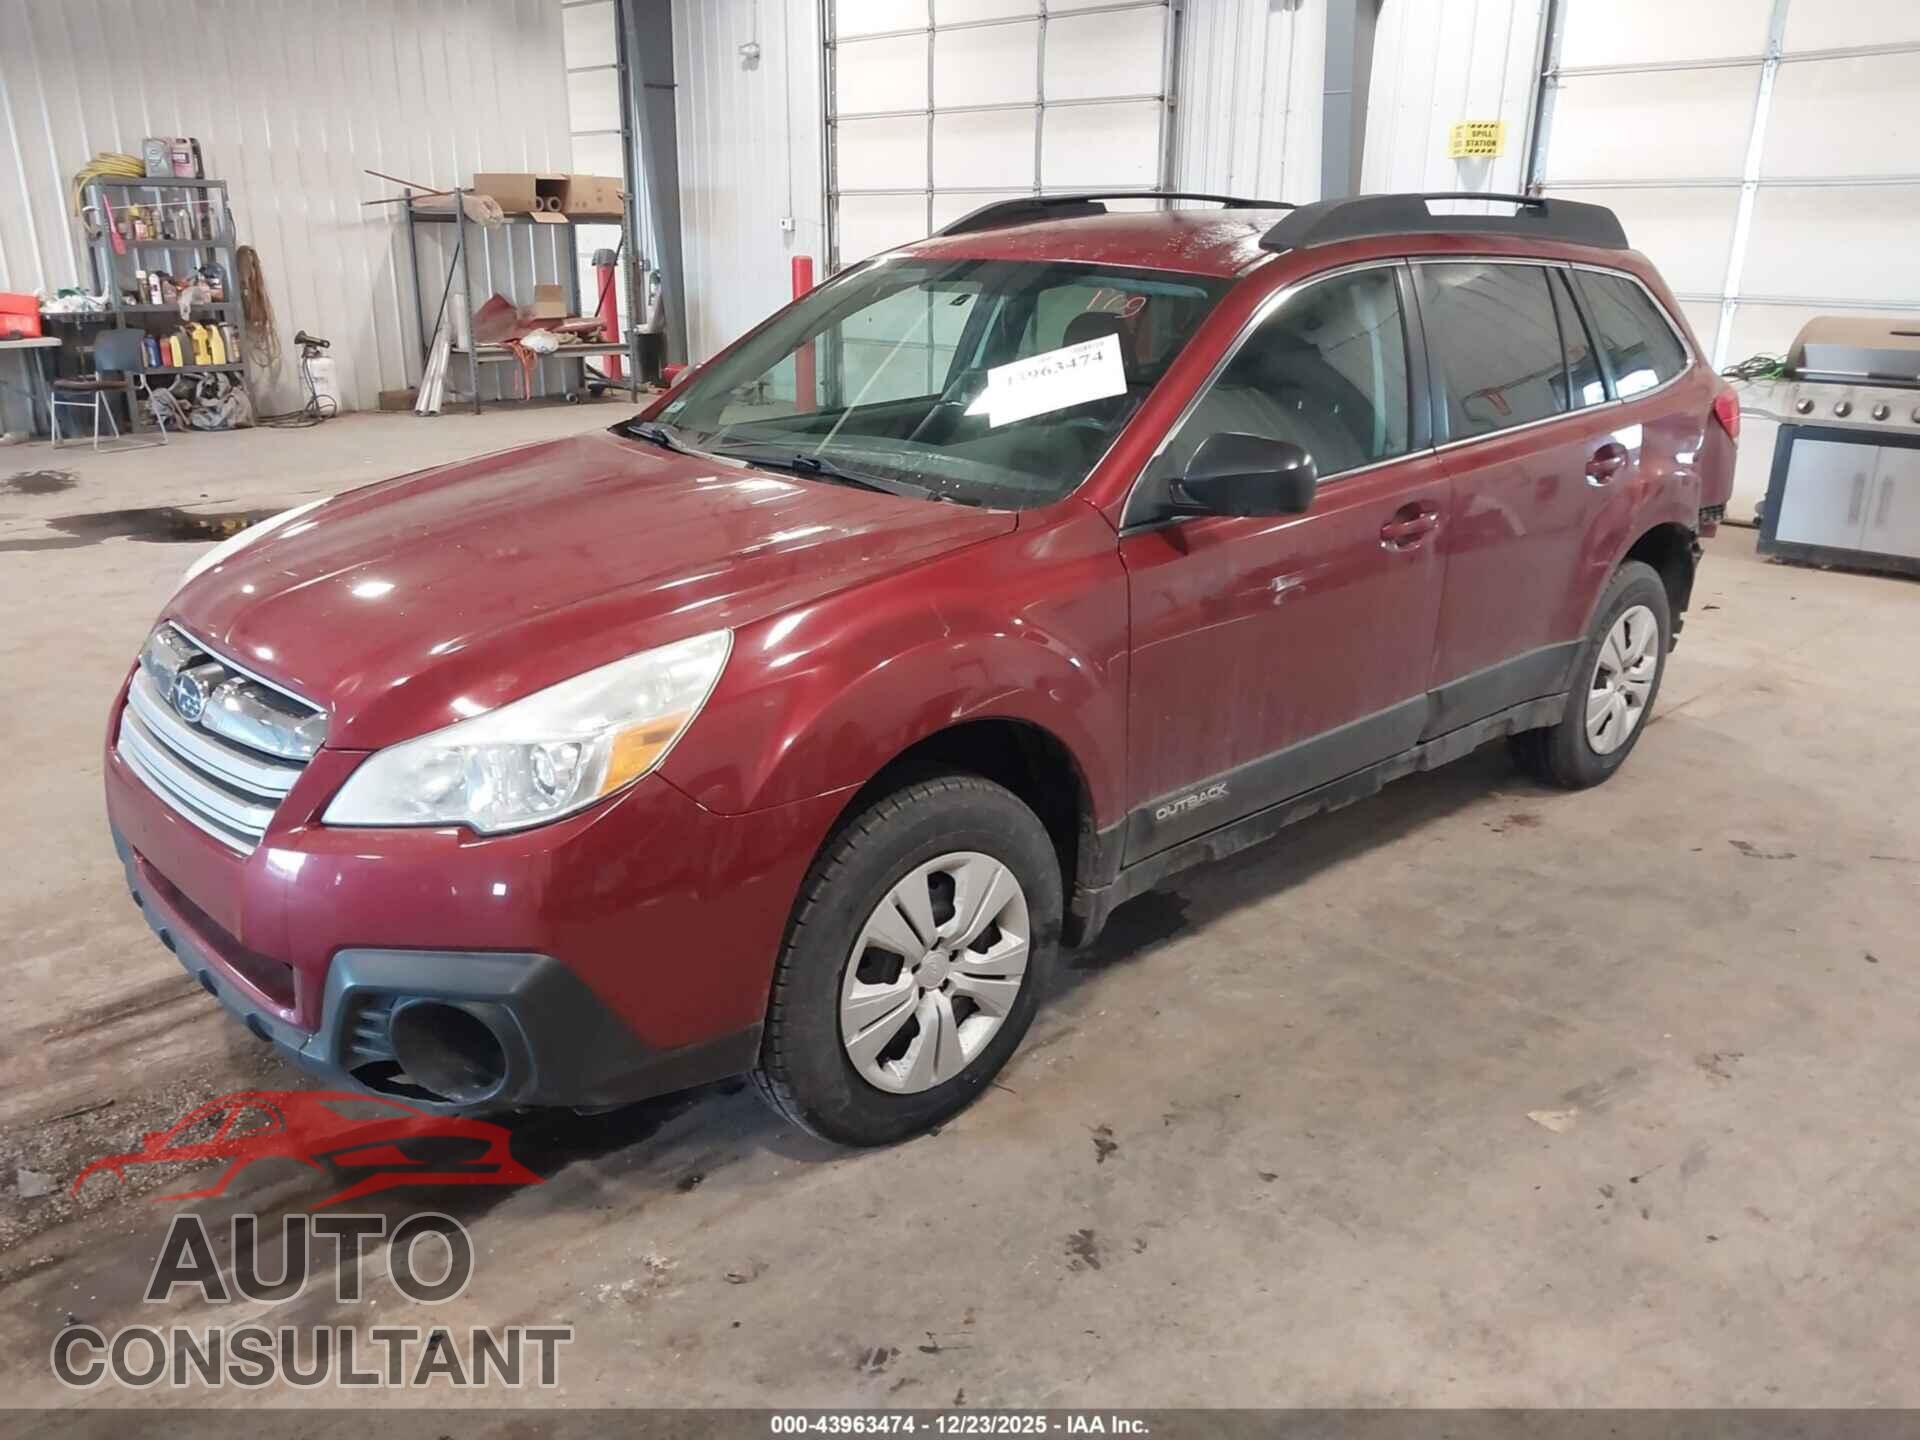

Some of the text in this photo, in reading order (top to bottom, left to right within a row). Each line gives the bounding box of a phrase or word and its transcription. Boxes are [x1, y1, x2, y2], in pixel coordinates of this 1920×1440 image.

[1465, 140, 1497, 148] STATION
[1471, 130, 1493, 138] SPILL
[1006, 349, 1104, 386] 963474
[1155, 783, 1231, 820] OUTBACK
